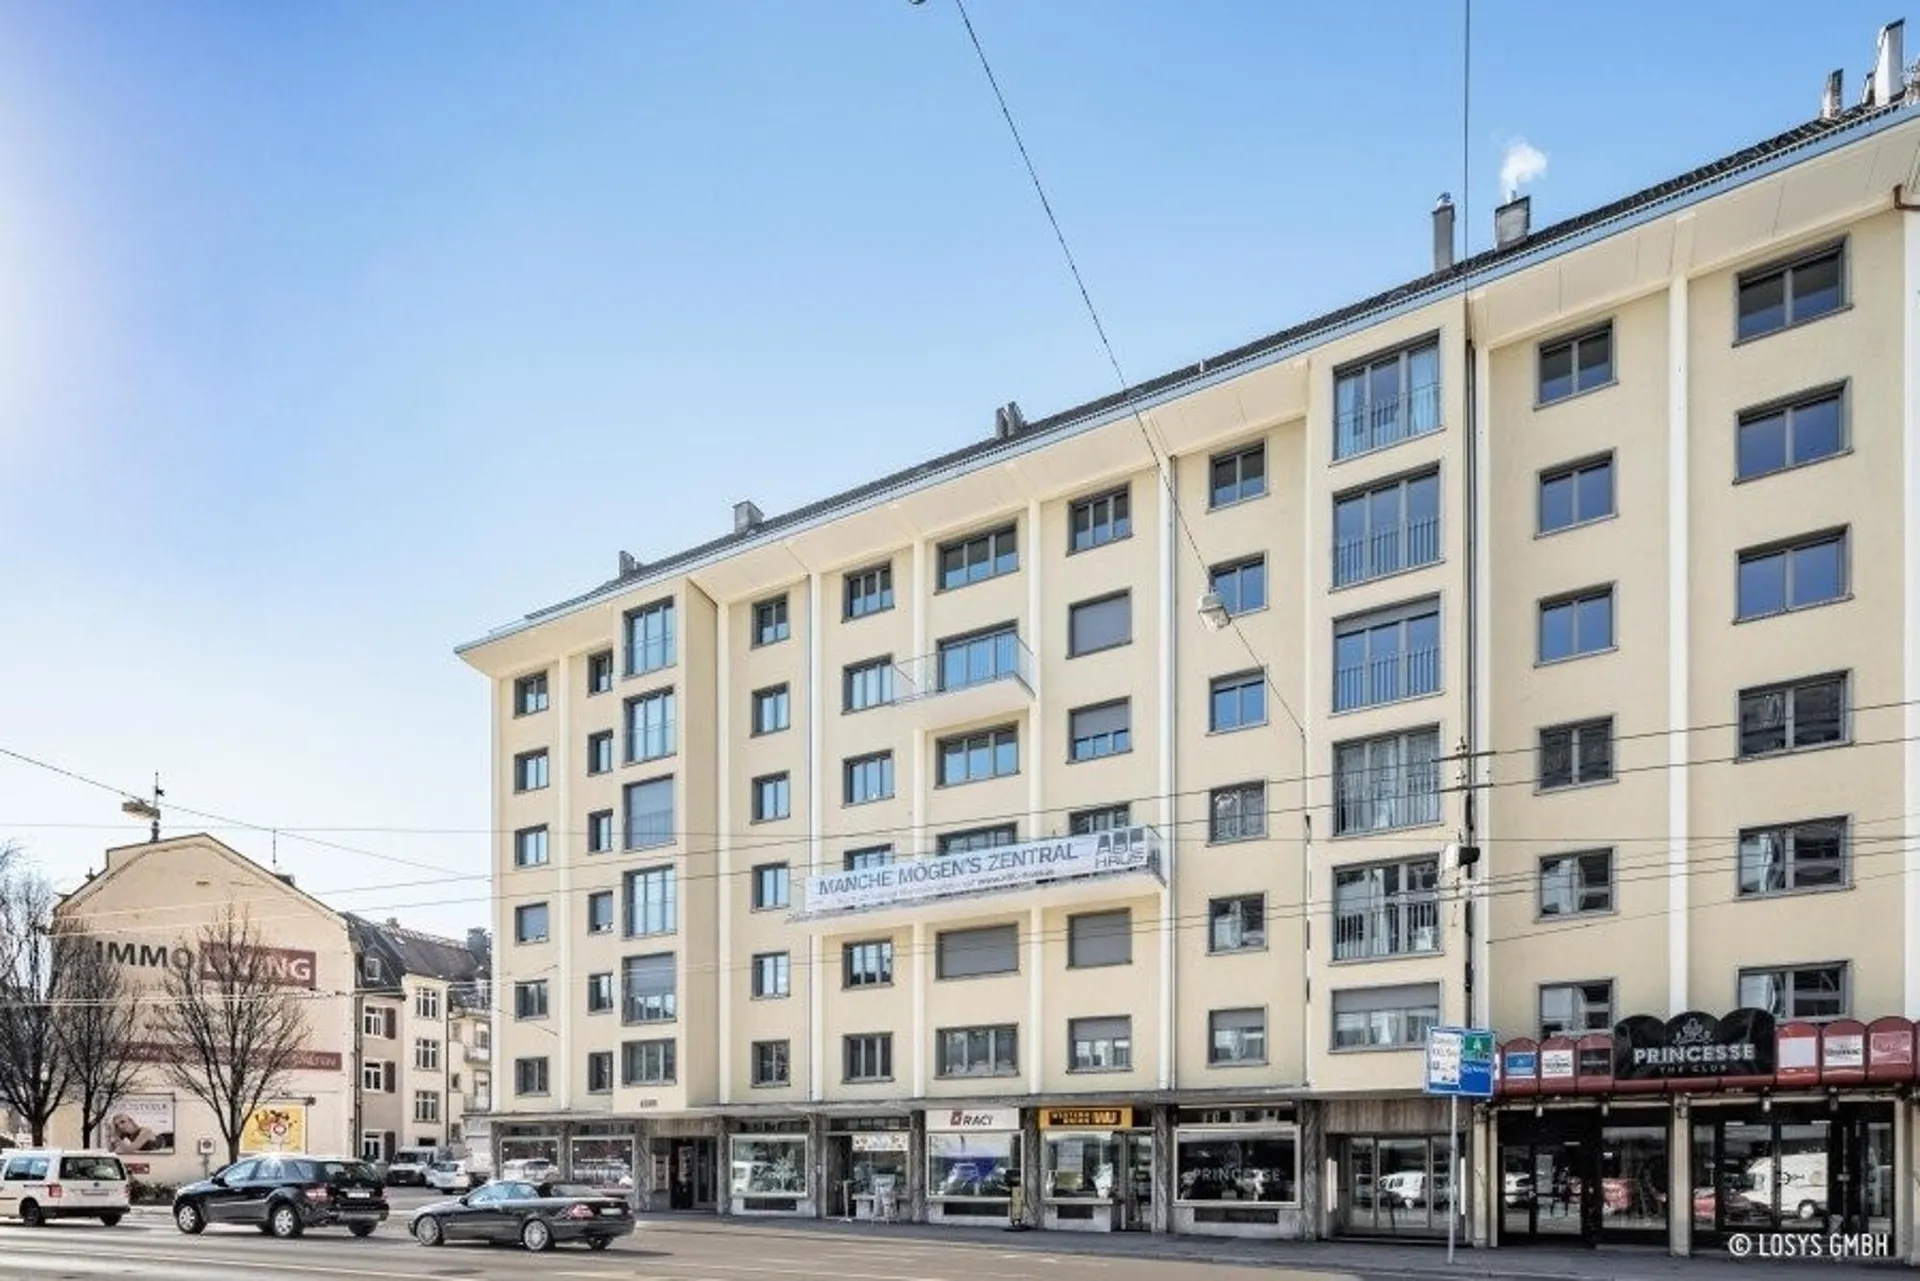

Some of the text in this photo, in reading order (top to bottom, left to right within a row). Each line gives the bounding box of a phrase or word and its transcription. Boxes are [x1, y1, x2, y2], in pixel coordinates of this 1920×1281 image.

[819, 870, 893, 895] MANCHE
[988, 843, 1079, 871] ZENTRAL
[1633, 1044, 1755, 1064] PRINCESSE
[1193, 1166, 1281, 1181] PRINCESE
